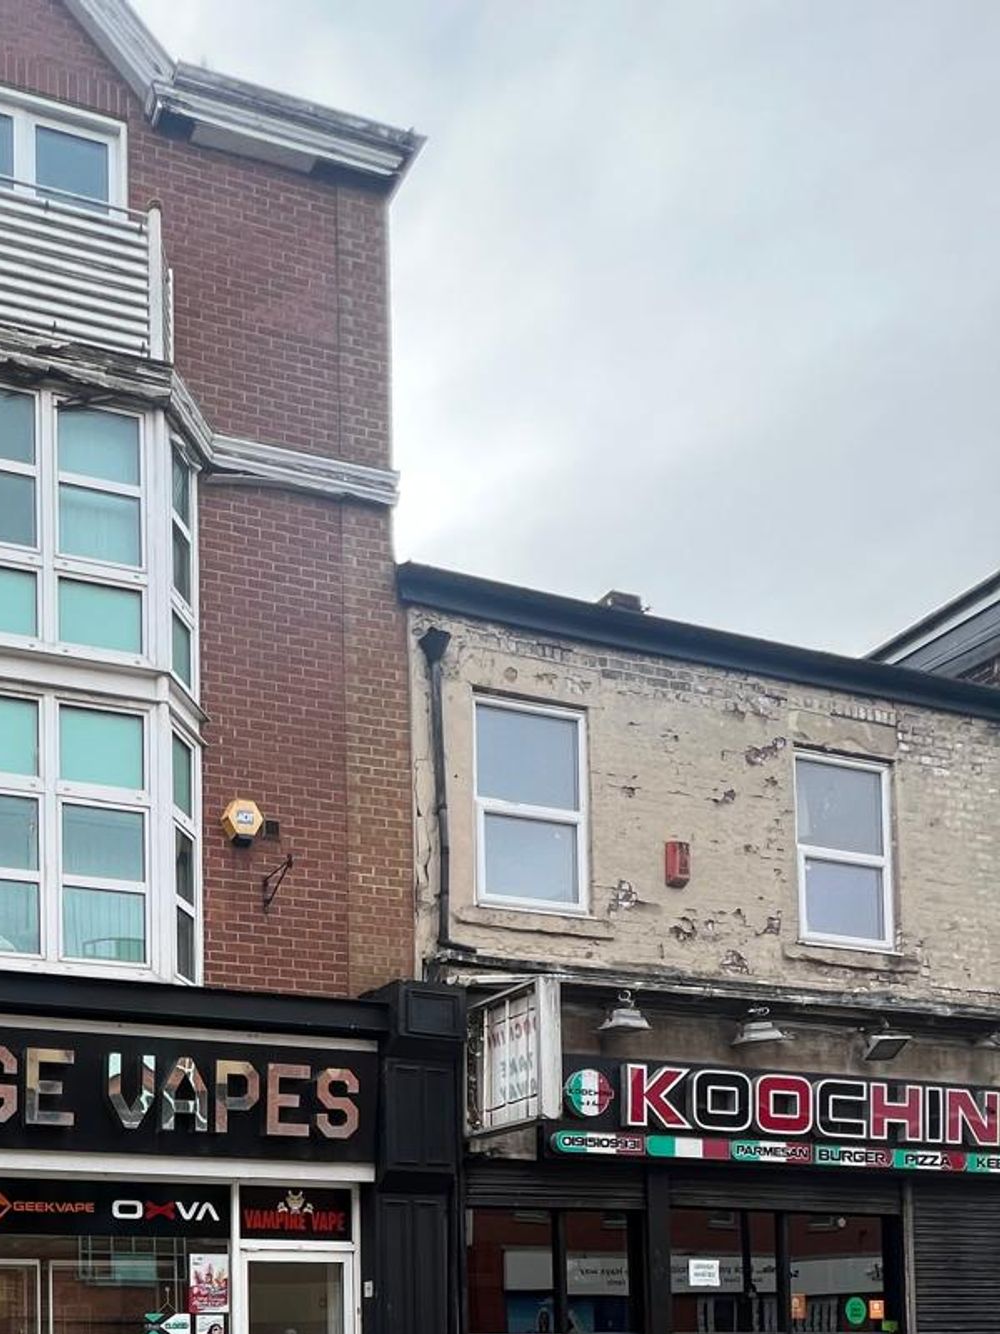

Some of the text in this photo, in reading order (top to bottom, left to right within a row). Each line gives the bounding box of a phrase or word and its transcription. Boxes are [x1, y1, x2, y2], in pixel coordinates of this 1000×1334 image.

[107, 1052, 360, 1140] VAPES
[625, 1063, 1000, 1147] KOOCHIN
[735, 1145, 1000, 1169] PARMESAN BURGER PIZZA KE
[12, 1200, 96, 1214] GEEKVAPE
[111, 1200, 220, 1222] OXVA
[244, 1208, 346, 1232] VAMPIRE VAPE
